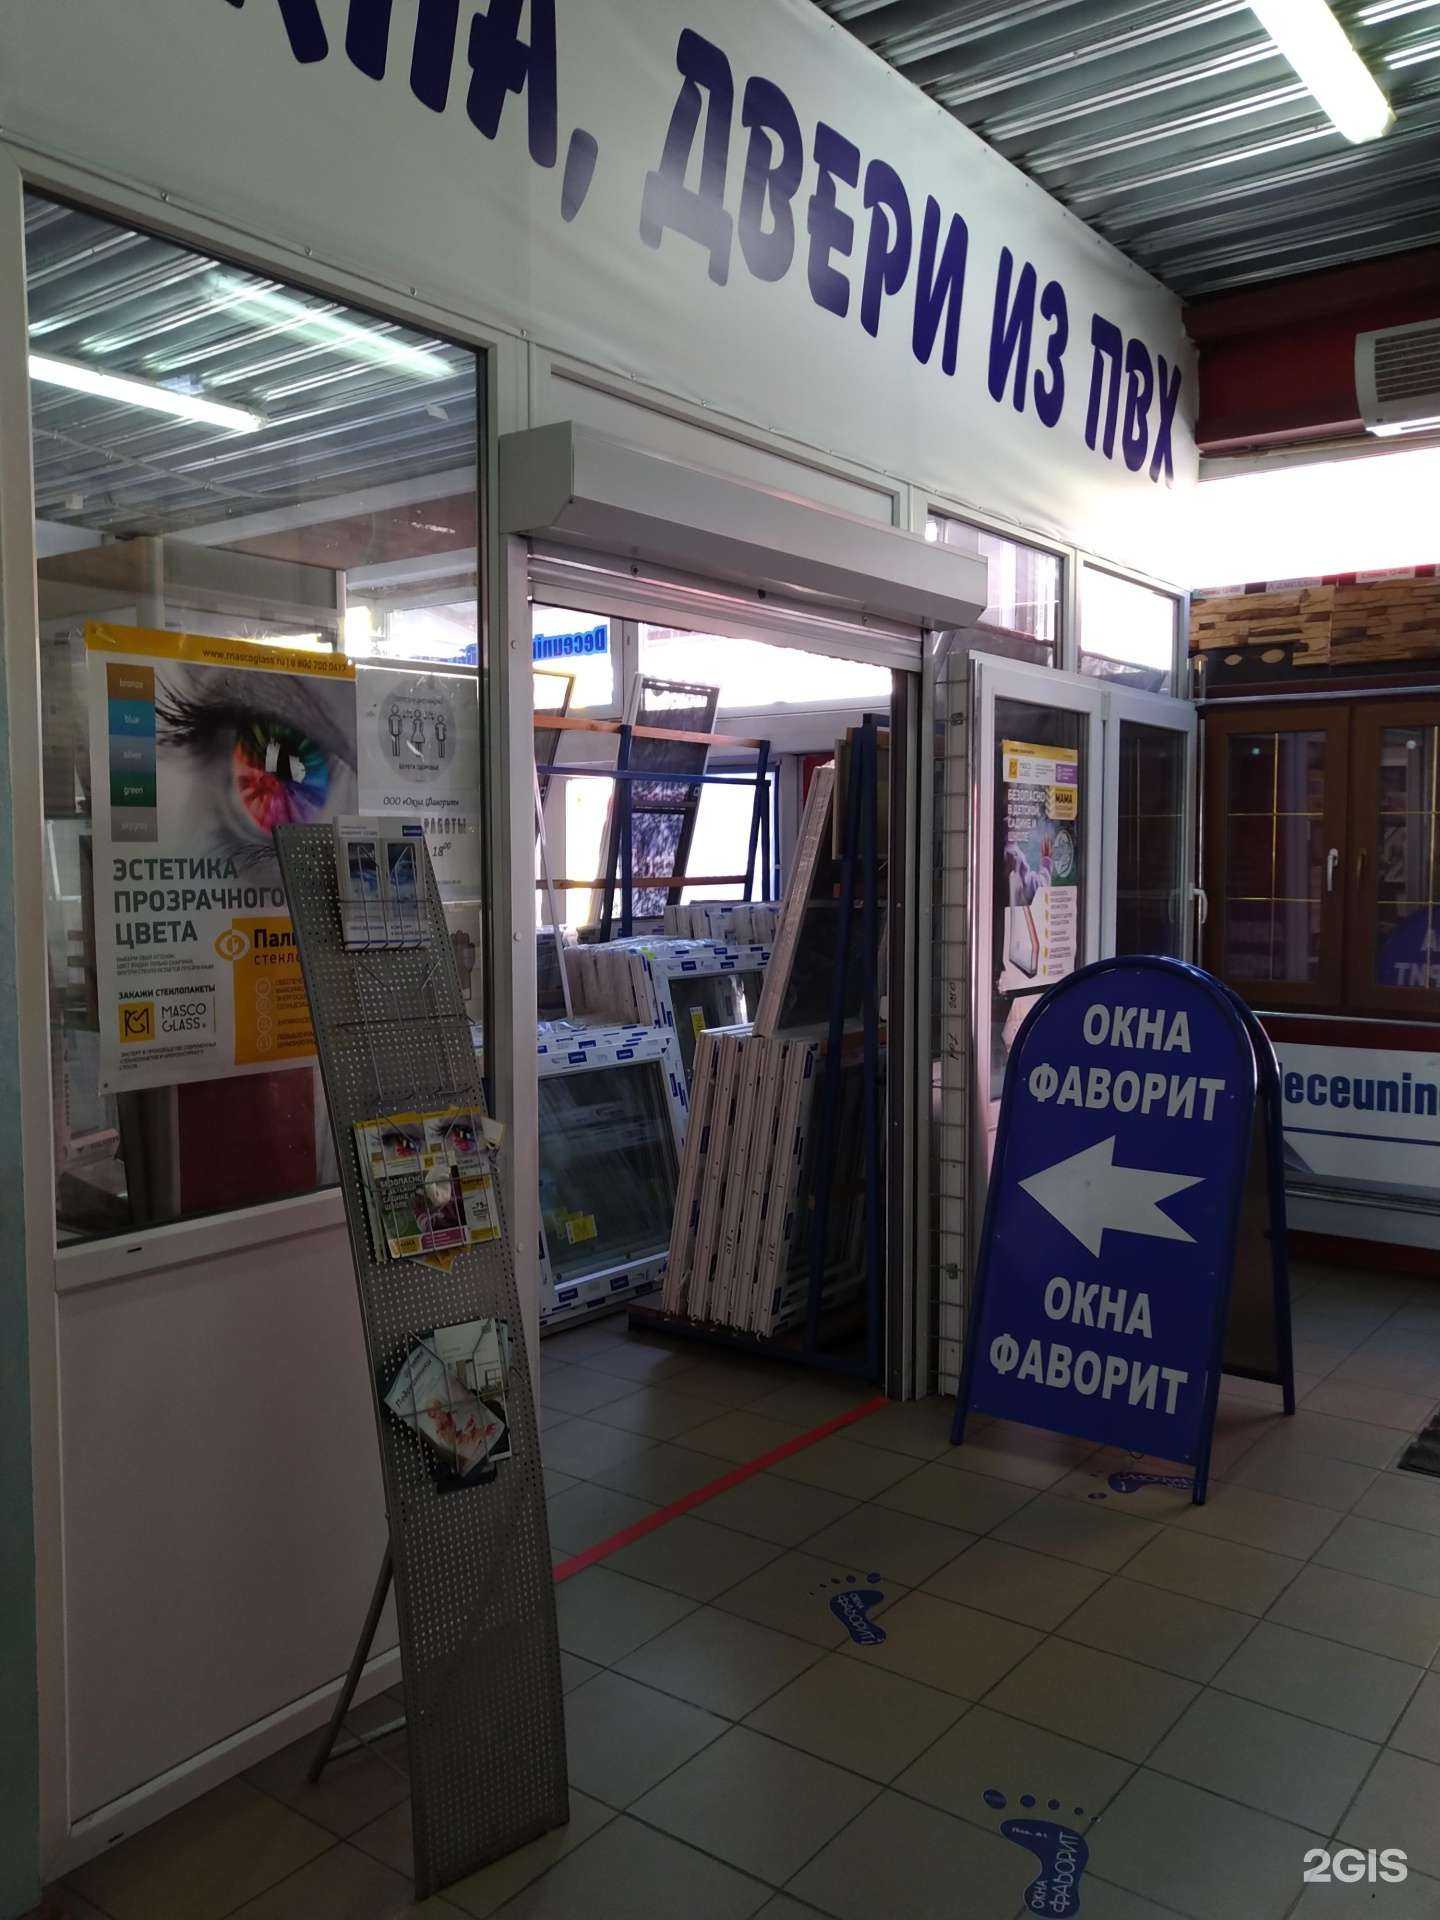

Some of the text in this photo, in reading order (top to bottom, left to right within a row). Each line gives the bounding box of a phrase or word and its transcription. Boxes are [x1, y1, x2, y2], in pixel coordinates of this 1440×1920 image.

[640, 28, 968, 376] ДВЕРИ
[987, 247, 1068, 428] ИЗ
[1086, 312, 1183, 487] ПВХ
[123, 786, 144, 796] green
[112, 857, 239, 882] ЭСТЕТИКА
[114, 886, 285, 914] ПРОЗРАЧНОГО
[115, 920, 198, 950] ЦВЕТА
[118, 984, 216, 1000] ЗАКАЖИ СТЕКЛОПАКЕТЫ
[161, 1003, 207, 1020] MASCO
[1082, 1003, 1192, 1054] ОКНА
[1028, 1062, 1227, 1122] ФАВОРИТ
[1043, 1276, 1153, 1339] ОКНА
[989, 1333, 1189, 1415] ФАВОРИТ
[1049, 1831, 1081, 1913] ФАВОРИТ
[1031, 1879, 1049, 1909] ОКНА
